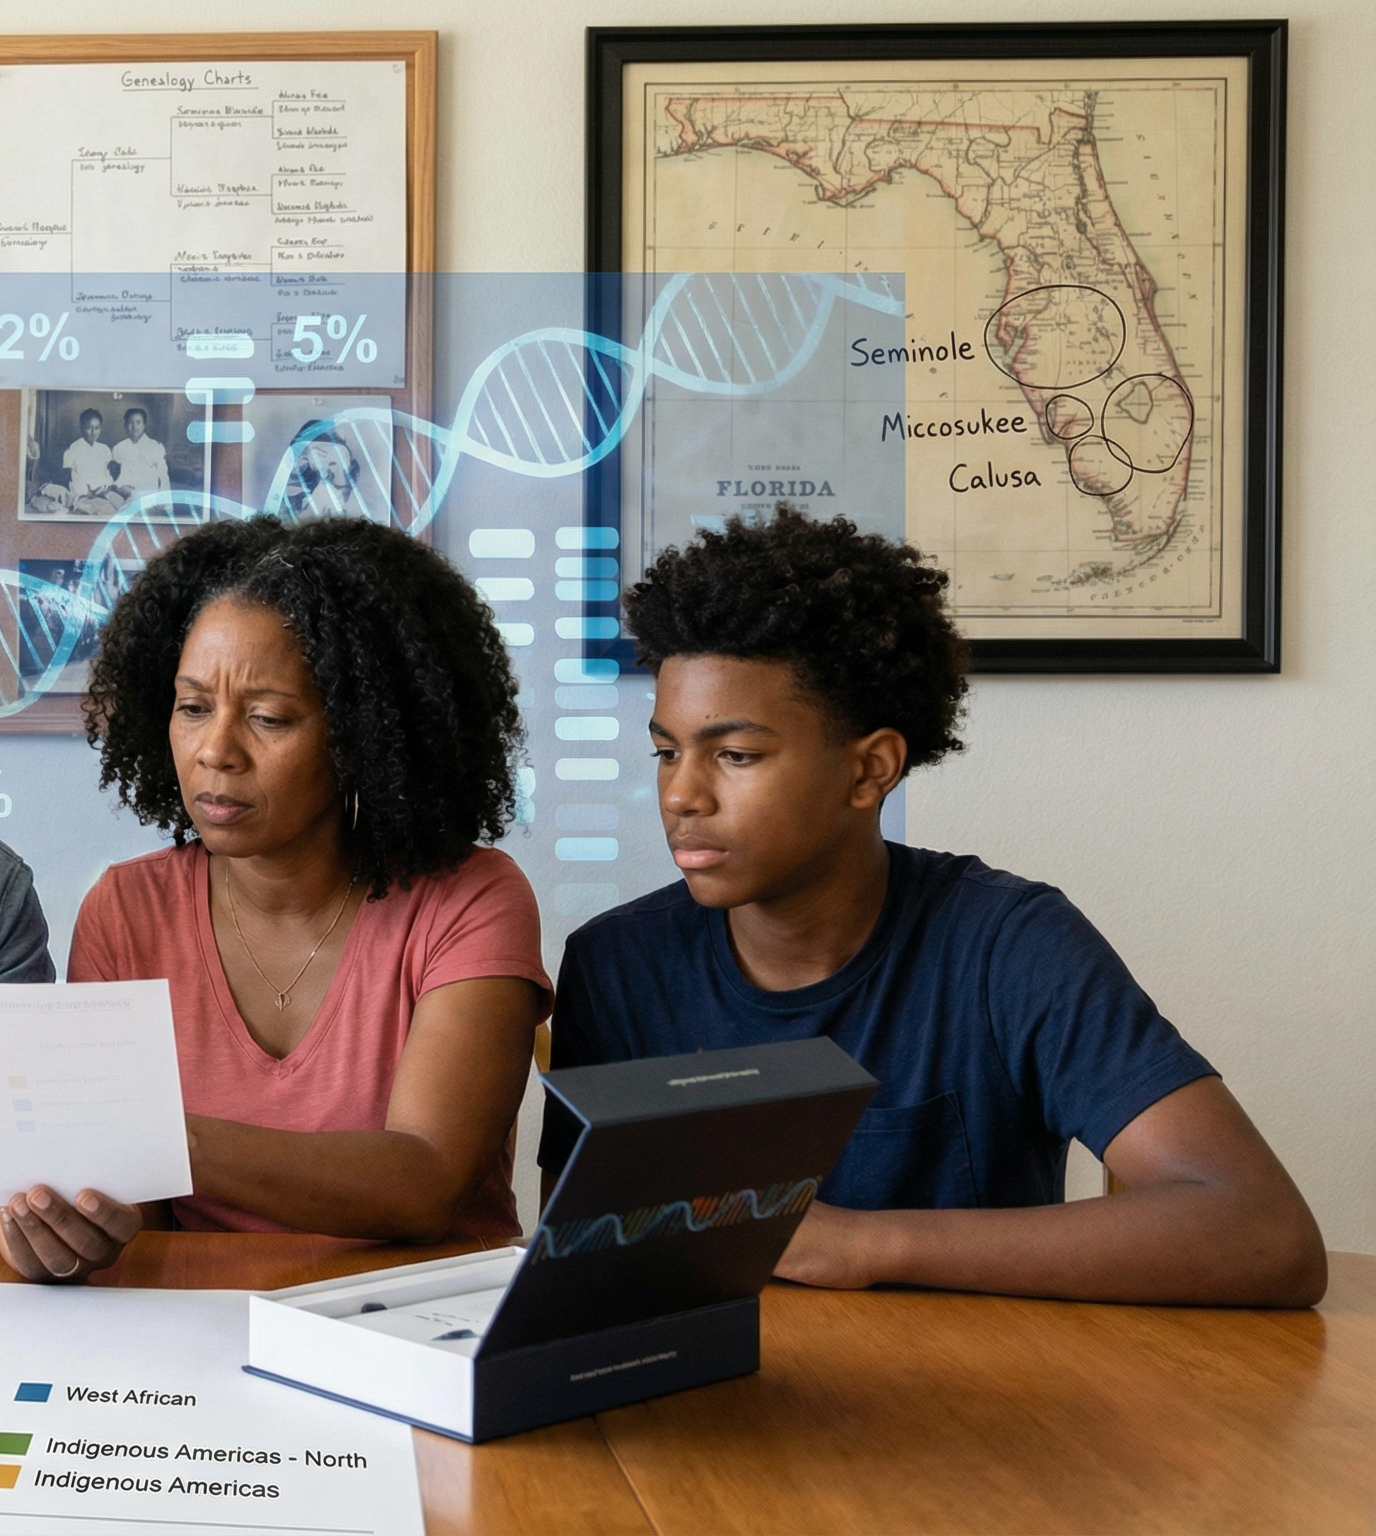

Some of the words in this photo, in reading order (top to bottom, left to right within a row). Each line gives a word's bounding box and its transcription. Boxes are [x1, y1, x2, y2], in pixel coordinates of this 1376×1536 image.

[121, 70, 196, 91] Genealogy
[203, 70, 253, 87] Charts
[850, 331, 976, 367] Seminole
[881, 408, 1028, 442] Miccosukee
[716, 480, 836, 497] FLORIDA
[949, 461, 1042, 492] Calusa
[66, 1386, 119, 1404] West
[122, 1389, 197, 1407] African
[45, 1437, 169, 1460] Indigenous
[174, 1444, 282, 1465] Americas
[305, 1450, 367, 1469] North
[34, 1469, 162, 1493] Indigenous
[167, 1476, 280, 1498] Americas
